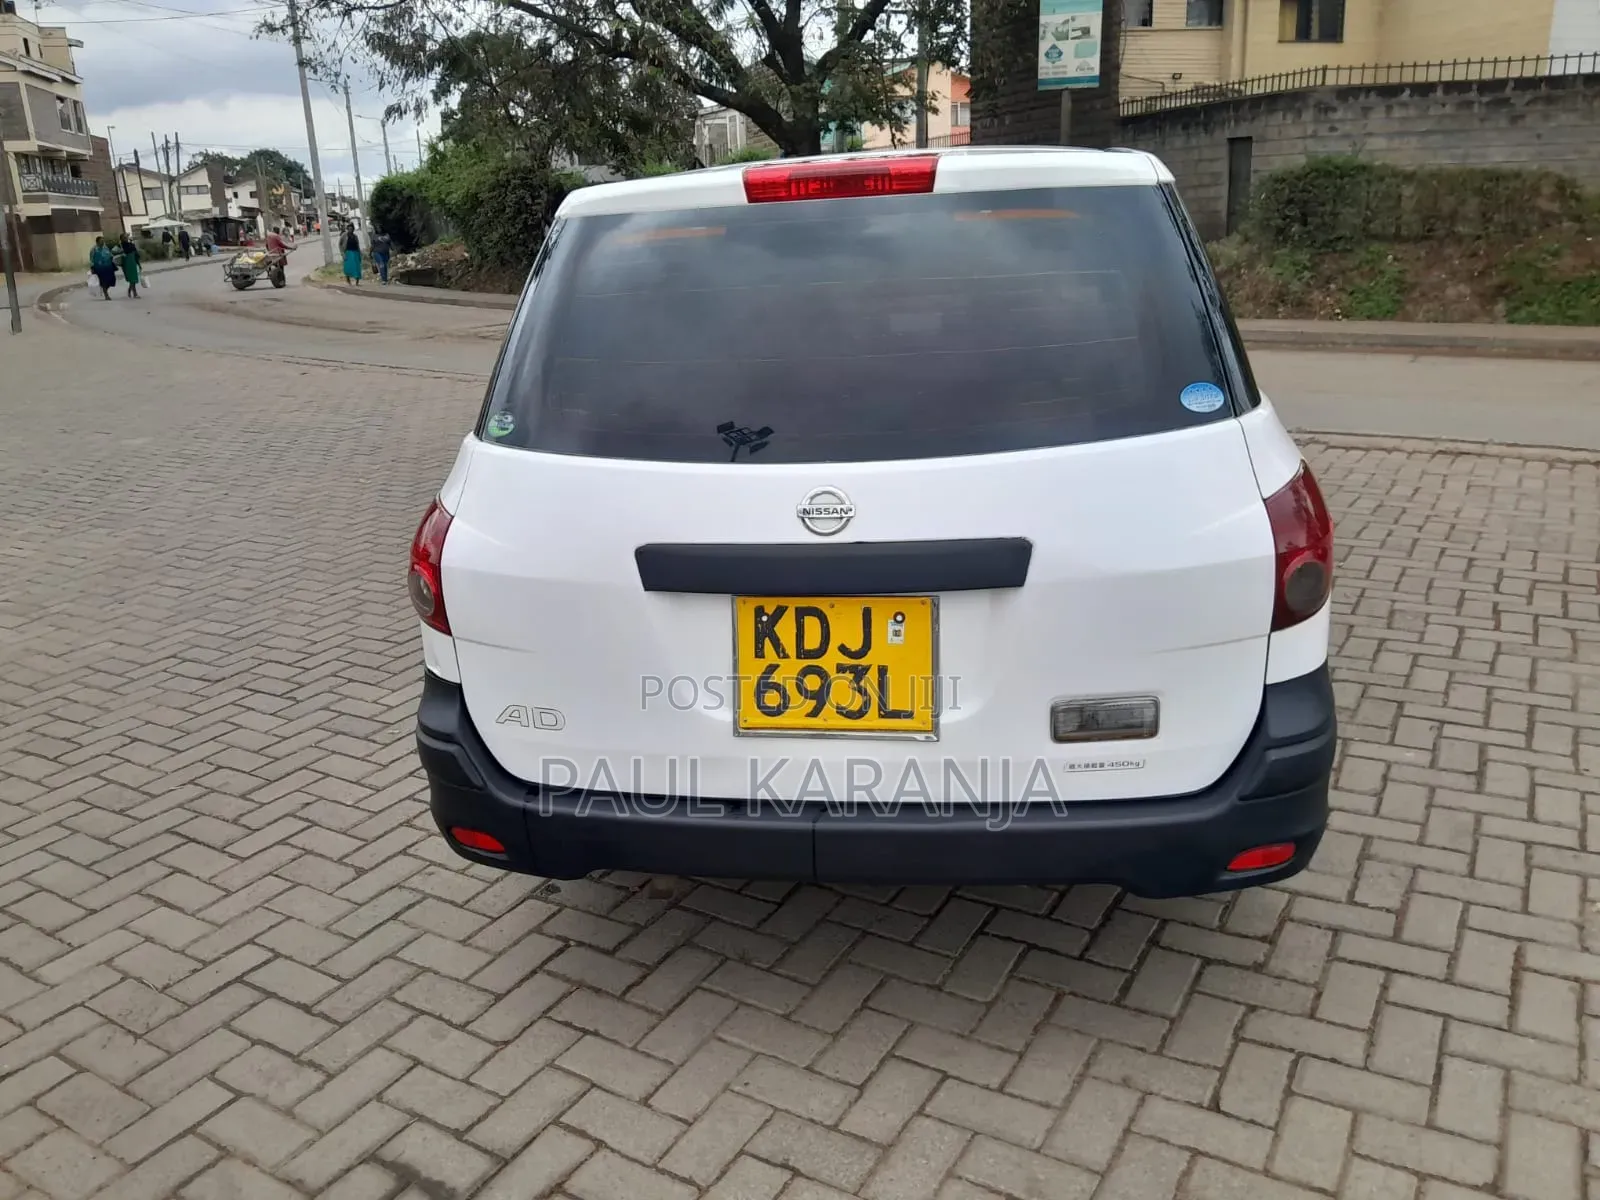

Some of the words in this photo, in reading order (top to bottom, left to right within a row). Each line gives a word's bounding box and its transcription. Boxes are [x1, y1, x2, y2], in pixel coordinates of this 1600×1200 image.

[802, 507, 848, 516] NISSAN
[754, 605, 872, 660] KDJ
[754, 663, 915, 720] 693L
[495, 704, 567, 732] AD
[1107, 760, 1141, 768] 450kg
